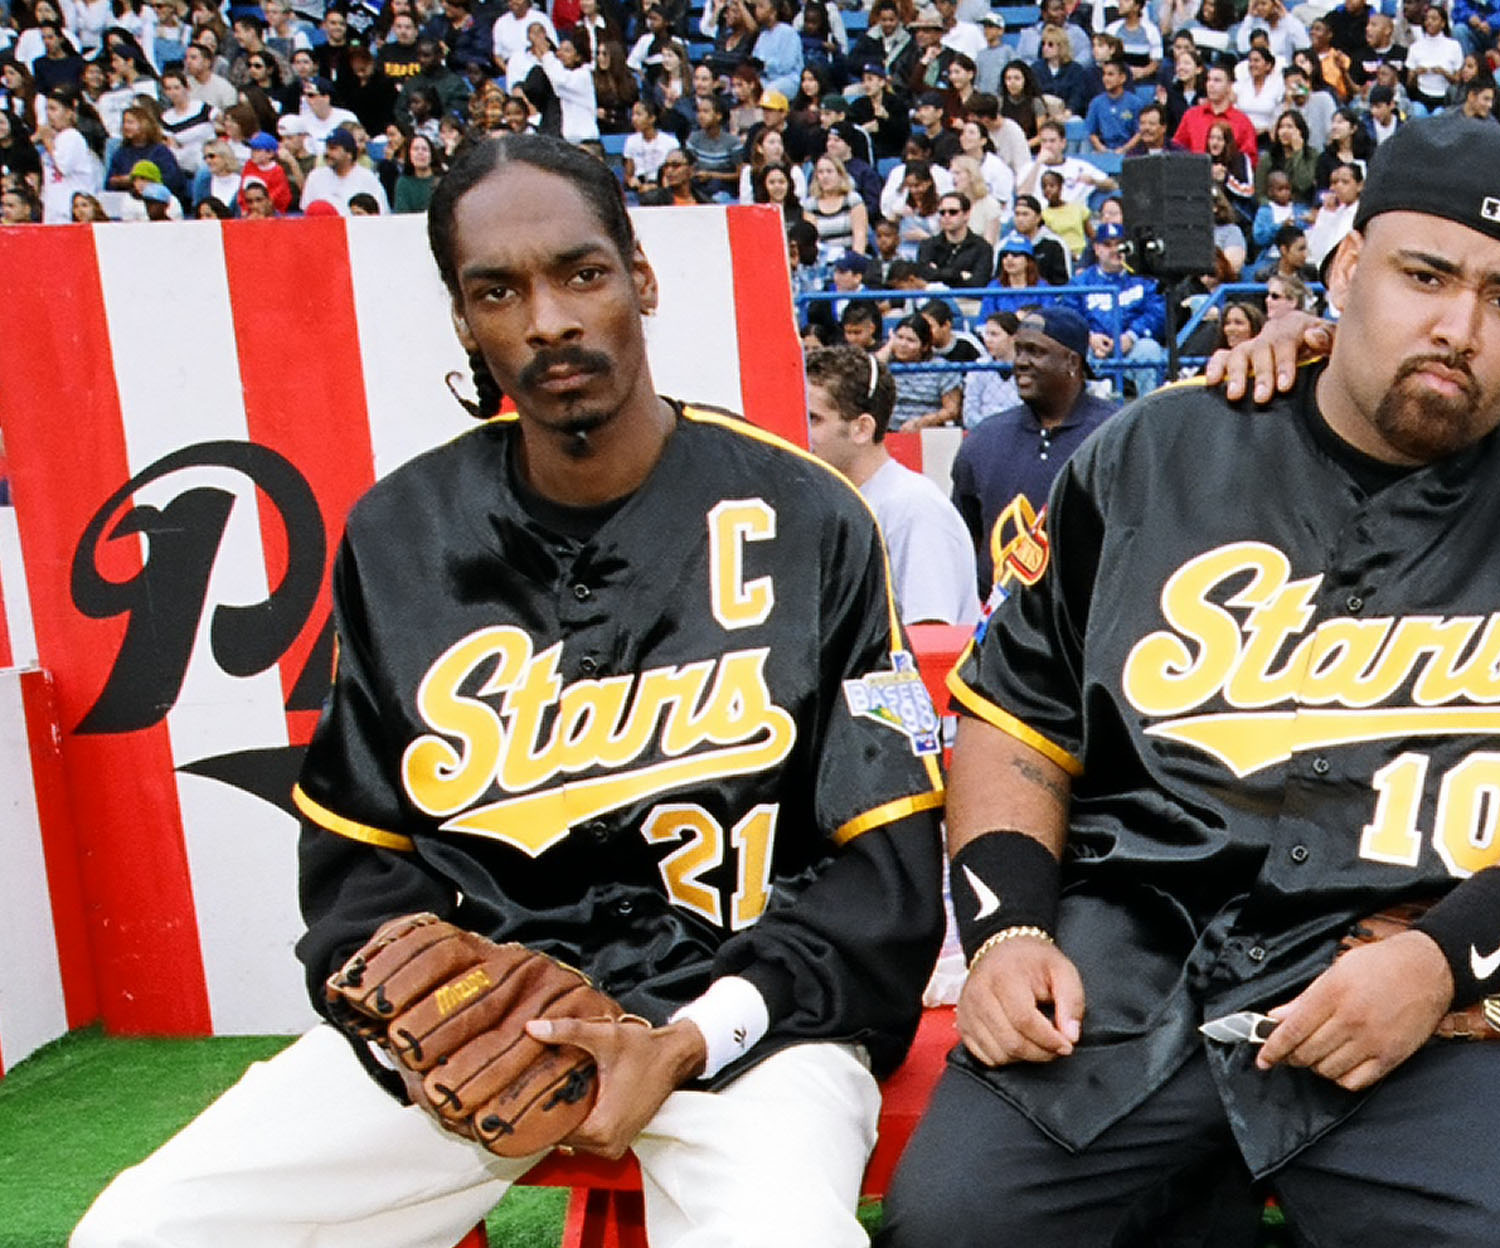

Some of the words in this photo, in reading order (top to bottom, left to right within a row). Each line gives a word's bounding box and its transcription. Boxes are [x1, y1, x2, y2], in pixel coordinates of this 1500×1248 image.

[707, 497, 777, 631] C
[402, 624, 797, 818] Stars
[639, 802, 780, 932] 21
